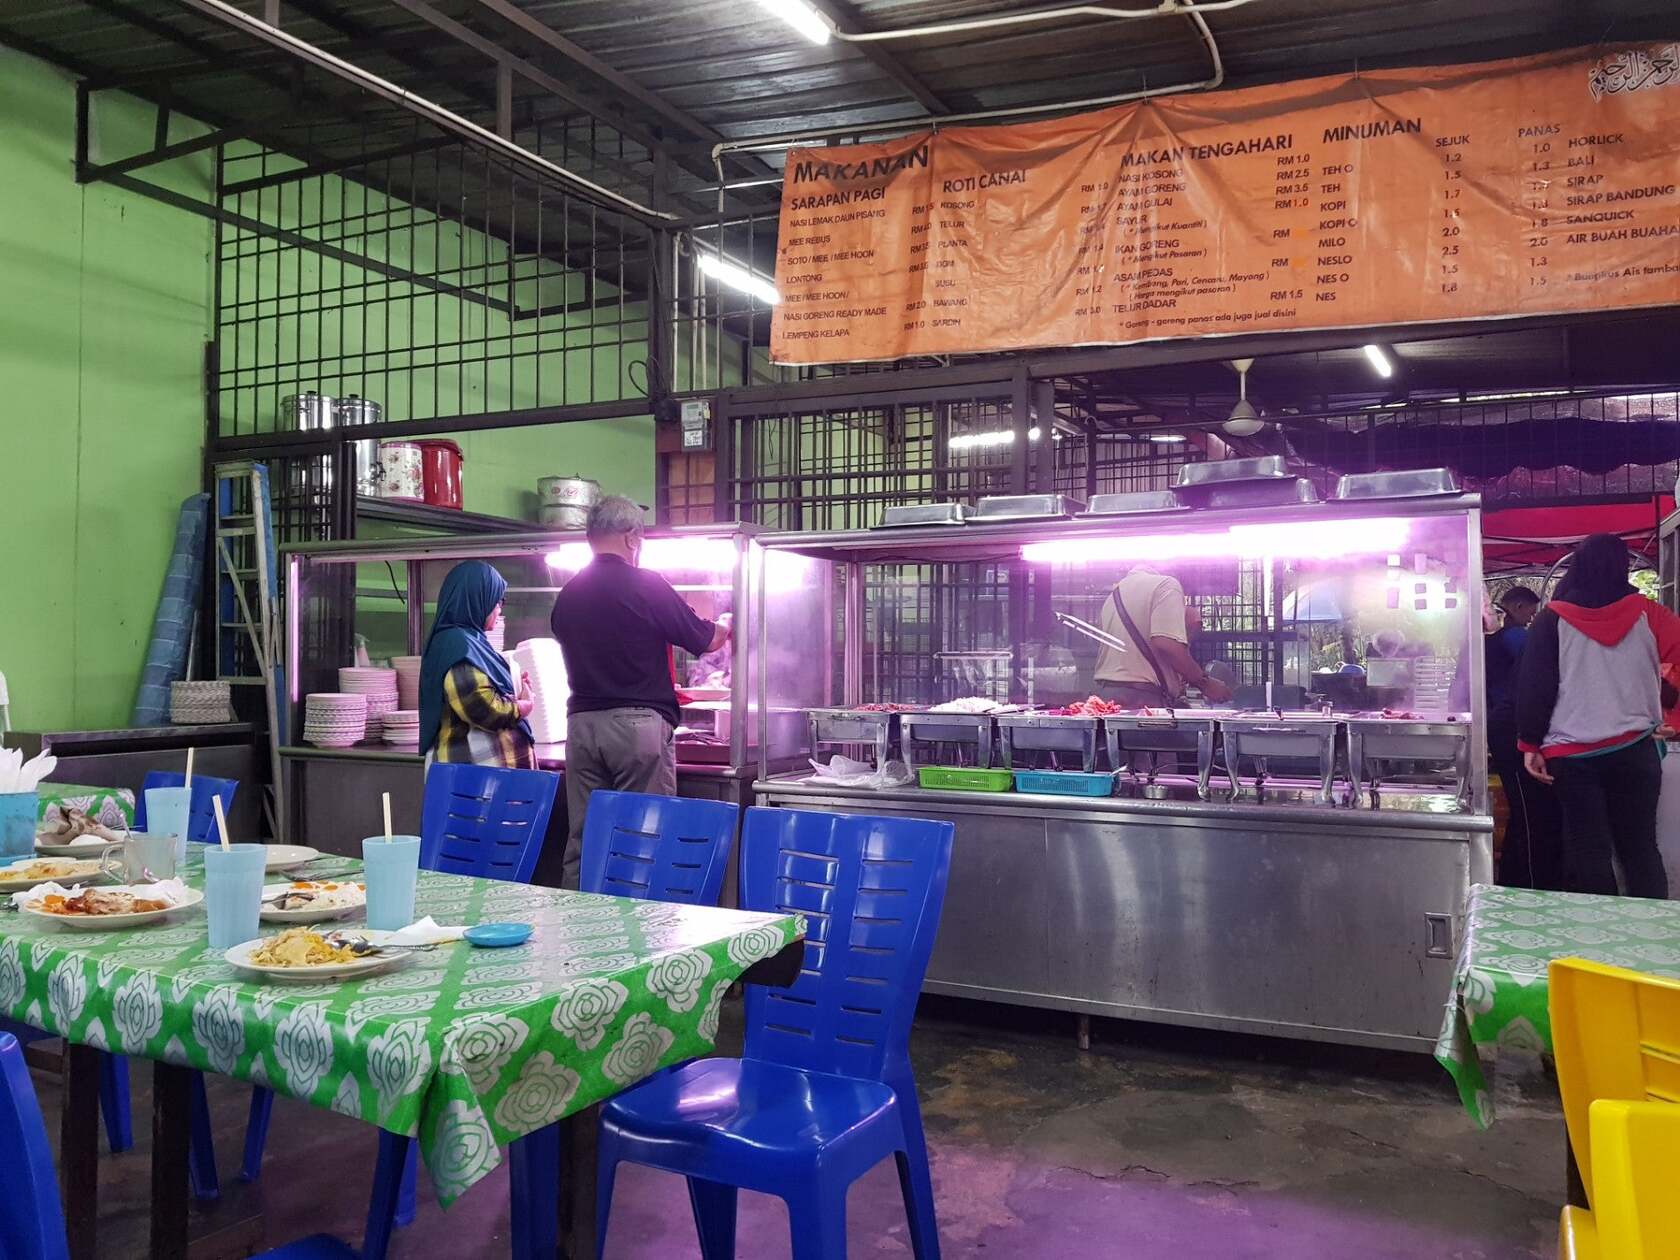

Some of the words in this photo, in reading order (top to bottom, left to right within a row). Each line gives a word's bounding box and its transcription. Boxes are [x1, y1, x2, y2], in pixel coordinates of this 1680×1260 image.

[1322, 118, 1422, 144] MINUMAN
[1518, 123, 1561, 138] PANAS
[1435, 134, 1470, 148] SEJUK
[1568, 133, 1624, 149] HORLICK
[1120, 146, 1184, 168] MAKAN
[1189, 134, 1293, 161] TENGAHARI
[1533, 143, 1550, 154] 1.0
[1277, 156, 1294, 166] RM
[1296, 153, 1310, 164] 1.0
[1445, 153, 1462, 163] 1.2
[1567, 155, 1595, 169] BALI
[793, 145, 928, 185] MAKANAN
[1322, 165, 1341, 176] TEH
[1119, 174, 1140, 183] NASI
[1142, 169, 1183, 181] KOSONG
[1276, 170, 1293, 181] RM
[1295, 168, 1310, 179] 2.5
[1445, 170, 1462, 181] 1.5
[943, 177, 975, 193] ROTI
[978, 169, 1026, 189] CANAI
[1567, 174, 1604, 188] SIRAP
[1144, 182, 1186, 195] GORENG
[1275, 185, 1293, 195] RM
[1321, 184, 1341, 194] TEH
[791, 192, 850, 211] SARAPAN
[853, 187, 885, 202] PAGI
[1566, 192, 1603, 207] SIRAP
[1606, 184, 1676, 203] BANDUNG
[940, 200, 975, 209] KOSONG
[1275, 200, 1292, 210] RM
[1294, 198, 1309, 208] 1.0
[1320, 201, 1346, 213] KOPI
[790, 219, 808, 228] NASI
[808, 216, 834, 226] LEMAK
[835, 213, 855, 224] DAUN
[855, 209, 885, 220] PISANG
[1566, 209, 1634, 225] SANQUICK
[940, 221, 965, 229] TELUR
[1319, 218, 1345, 230] KOPI
[1273, 228, 1290, 239] RM
[1442, 226, 1460, 238] 2.0
[1566, 233, 1587, 245] AIR
[1591, 228, 1628, 243] BUAH
[1631, 224, 1680, 239] BUAHA
[789, 238, 804, 246] MEE
[805, 235, 831, 245] REBUS
[938, 240, 968, 249] PLANTA
[1318, 237, 1346, 248] MILO
[1530, 236, 1548, 248] 2.0
[1442, 245, 1459, 256] 2.5
[788, 256, 808, 266] SOTO
[812, 254, 828, 263] MEE
[834, 252, 849, 261] MEE
[850, 249, 875, 259] HOON
[1271, 258, 1289, 267] RM
[1317, 254, 1352, 266] NESLO
[1530, 256, 1547, 267] 1.3
[1142, 268, 1173, 279] PEDAS
[1643, 264, 1680, 275] tamba
[786, 273, 822, 284] LONTONG
[1317, 273, 1337, 284] NES
[1340, 272, 1349, 282] O
[785, 294, 801, 302] MEE
[806, 292, 821, 301] MEE
[822, 291, 846, 300] HOON
[1270, 290, 1287, 300] RM
[1316, 292, 1336, 302] NES
[1142, 299, 1177, 309] DADAR
[783, 312, 803, 321] NASI
[803, 310, 834, 320] GORENG
[836, 309, 863, 318] READY
[864, 306, 886, 315] MADE
[782, 330, 819, 339] LEMPENG
[820, 328, 850, 337] KELAPA
